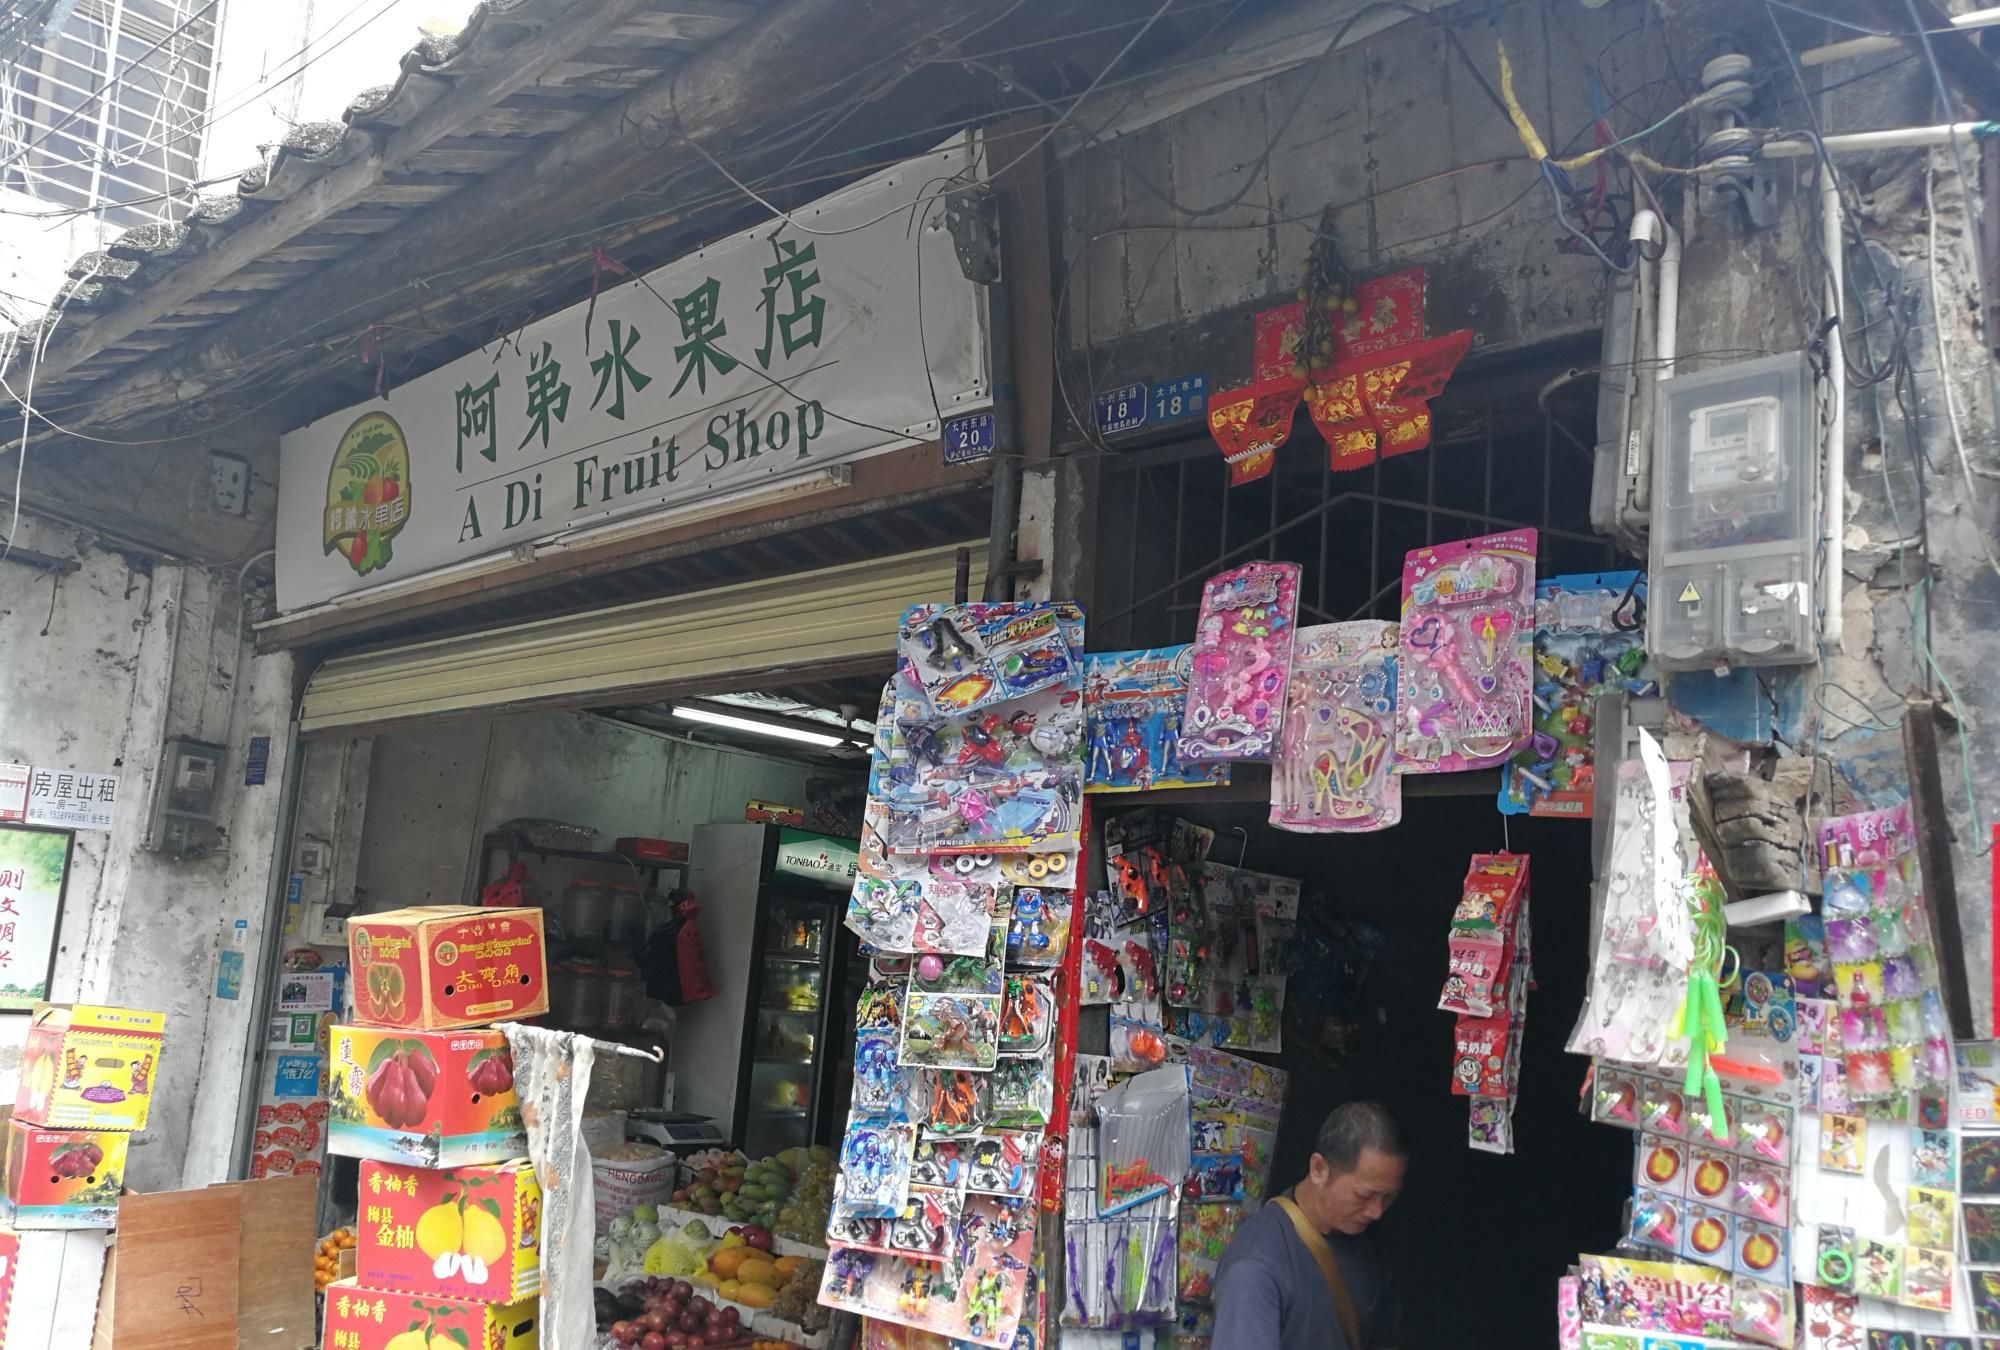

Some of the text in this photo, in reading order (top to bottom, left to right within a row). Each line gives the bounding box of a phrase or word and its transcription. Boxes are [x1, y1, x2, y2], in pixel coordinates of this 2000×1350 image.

[455, 240, 826, 474] 阿弟水果店
[1107, 402, 1127, 421] 18
[1157, 396, 1182, 418] 18
[952, 415, 987, 432] 大兴东路
[960, 430, 979, 448] 20
[458, 400, 824, 543] A Di Fruit Shop
[31, 771, 116, 802] 房屋出租
[786, 856, 820, 869] TONBAO
[455, 963, 519, 985] 大弯角
[368, 1171, 419, 1197] 香柚香
[608, 1168, 666, 1185] HENGDAWEI
[367, 1206, 394, 1224] 梅县
[376, 1223, 415, 1248] 金柚
[336, 1295, 387, 1324] 香柚香
[334, 1329, 361, 1350] 梅县
